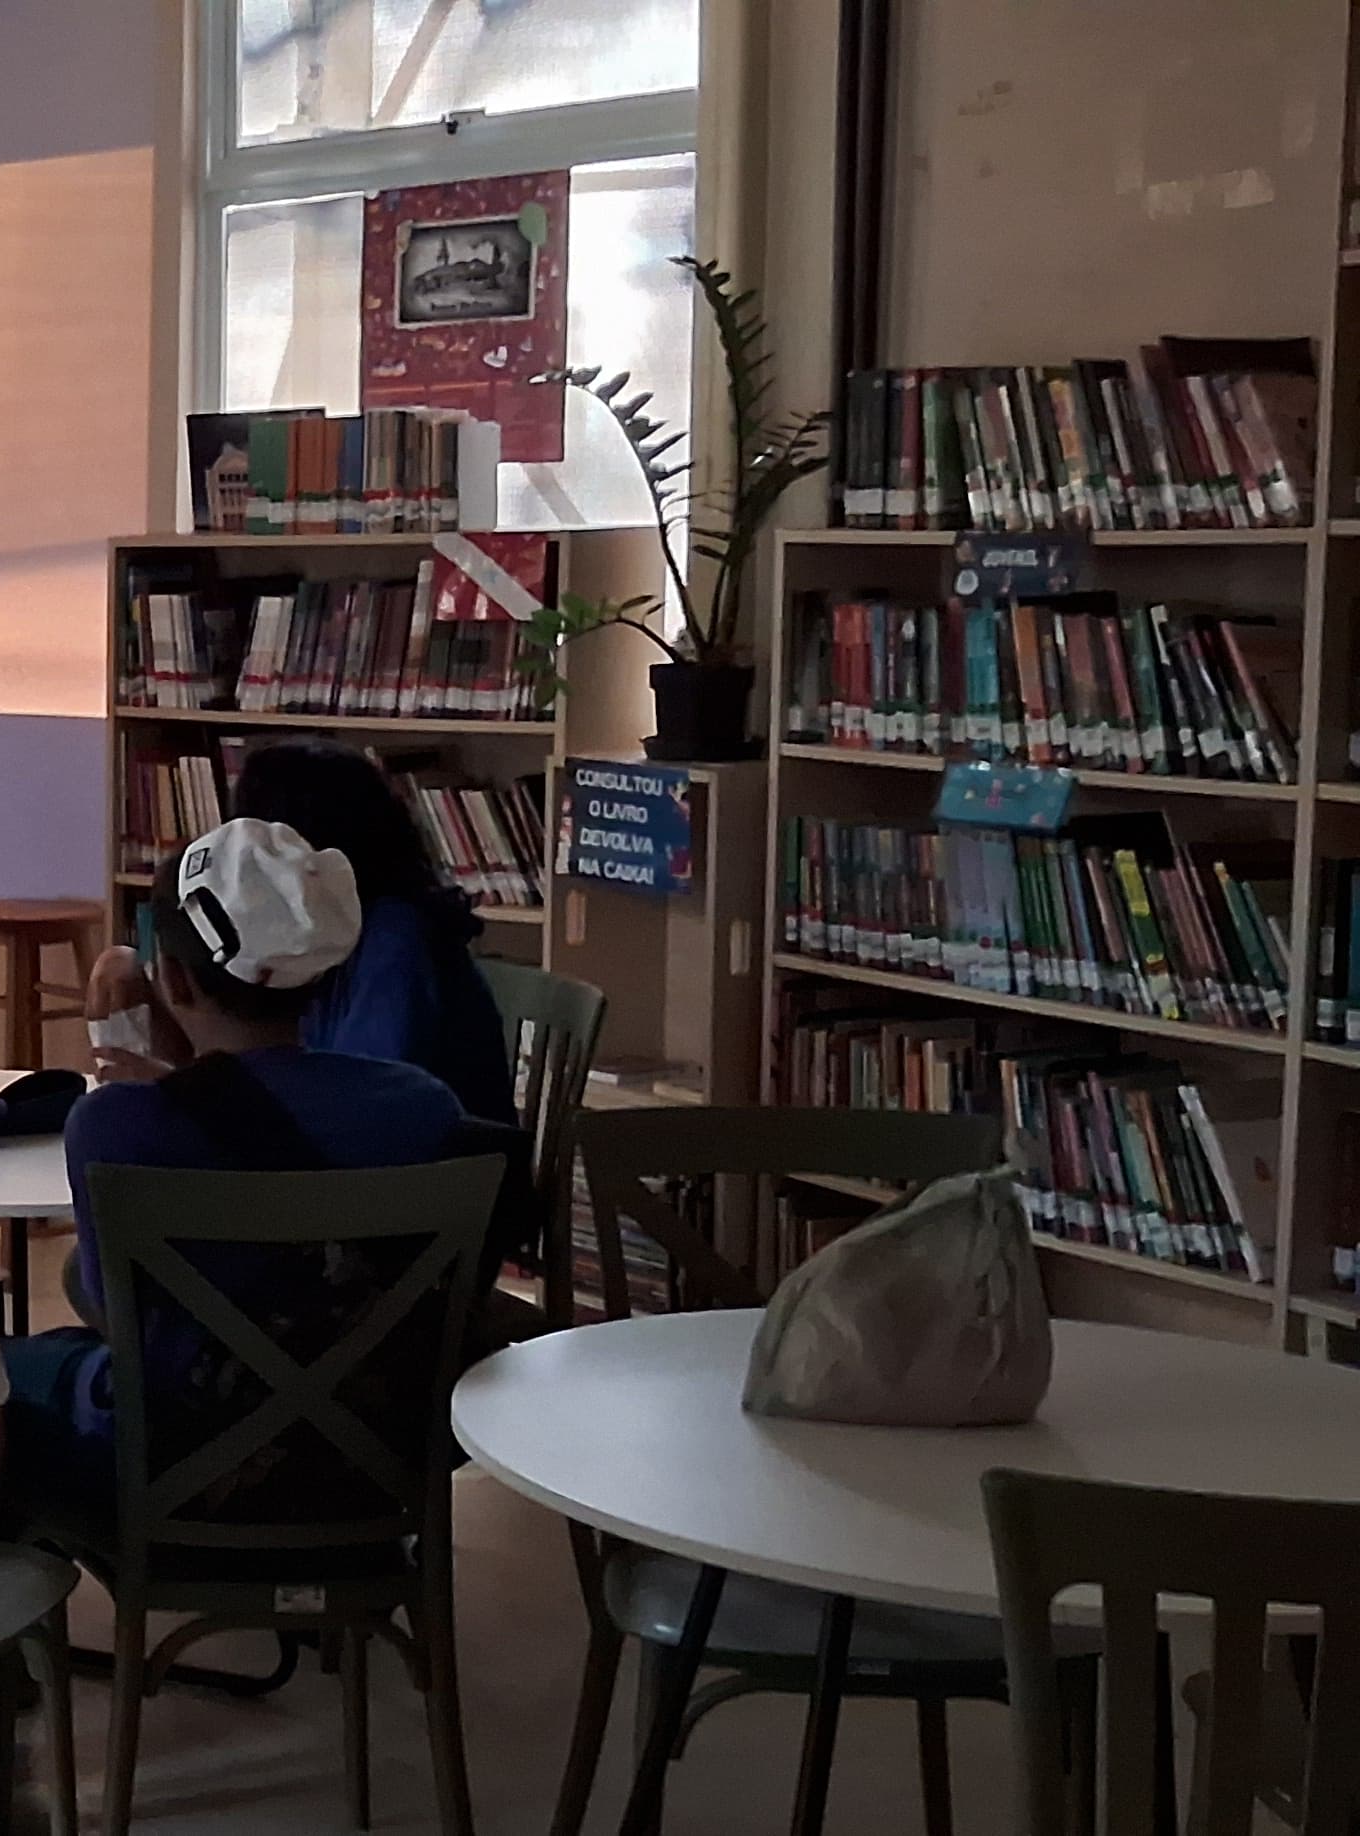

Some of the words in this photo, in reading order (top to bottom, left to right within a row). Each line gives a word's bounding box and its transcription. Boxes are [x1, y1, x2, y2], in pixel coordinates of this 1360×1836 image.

[576, 769, 663, 796] CONSULTOU
[588, 800, 601, 817] O
[603, 802, 648, 823] LIVRO
[580, 827, 654, 854] DEVOLVA
[578, 858, 600, 876] NA
